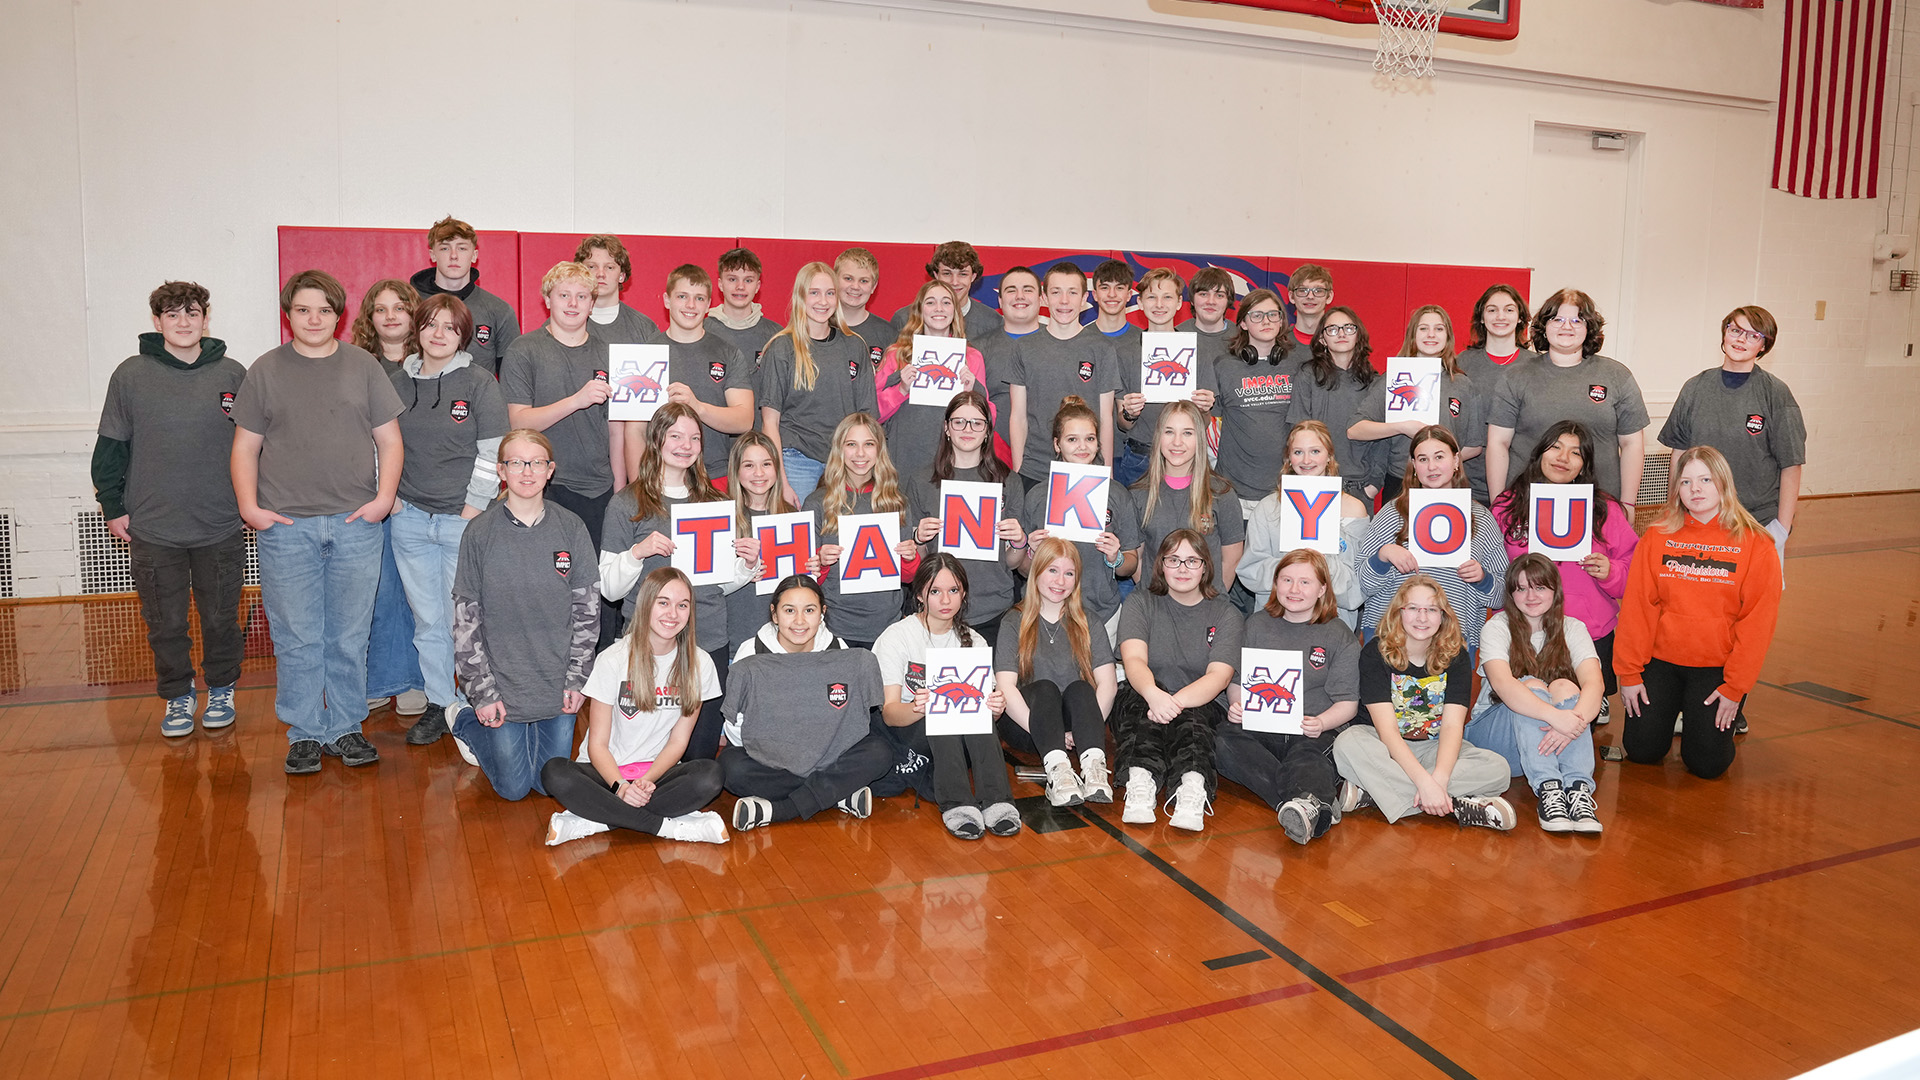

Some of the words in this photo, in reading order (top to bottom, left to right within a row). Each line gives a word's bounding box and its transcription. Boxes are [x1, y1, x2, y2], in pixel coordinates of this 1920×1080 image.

[1234, 383, 1293, 397] VOLUNTEE
[1242, 374, 1290, 389] IMPACT
[943, 495, 998, 549] N
[1046, 472, 1107, 530] K
[1284, 488, 1339, 541] Y
[1535, 497, 1589, 549] U
[677, 516, 731, 574] T
[758, 521, 812, 581] H
[843, 525, 898, 580] A
[1414, 502, 1468, 555] O
[1665, 539, 1741, 554] SUPPORTING
[829, 693, 847, 701] IMPACT
